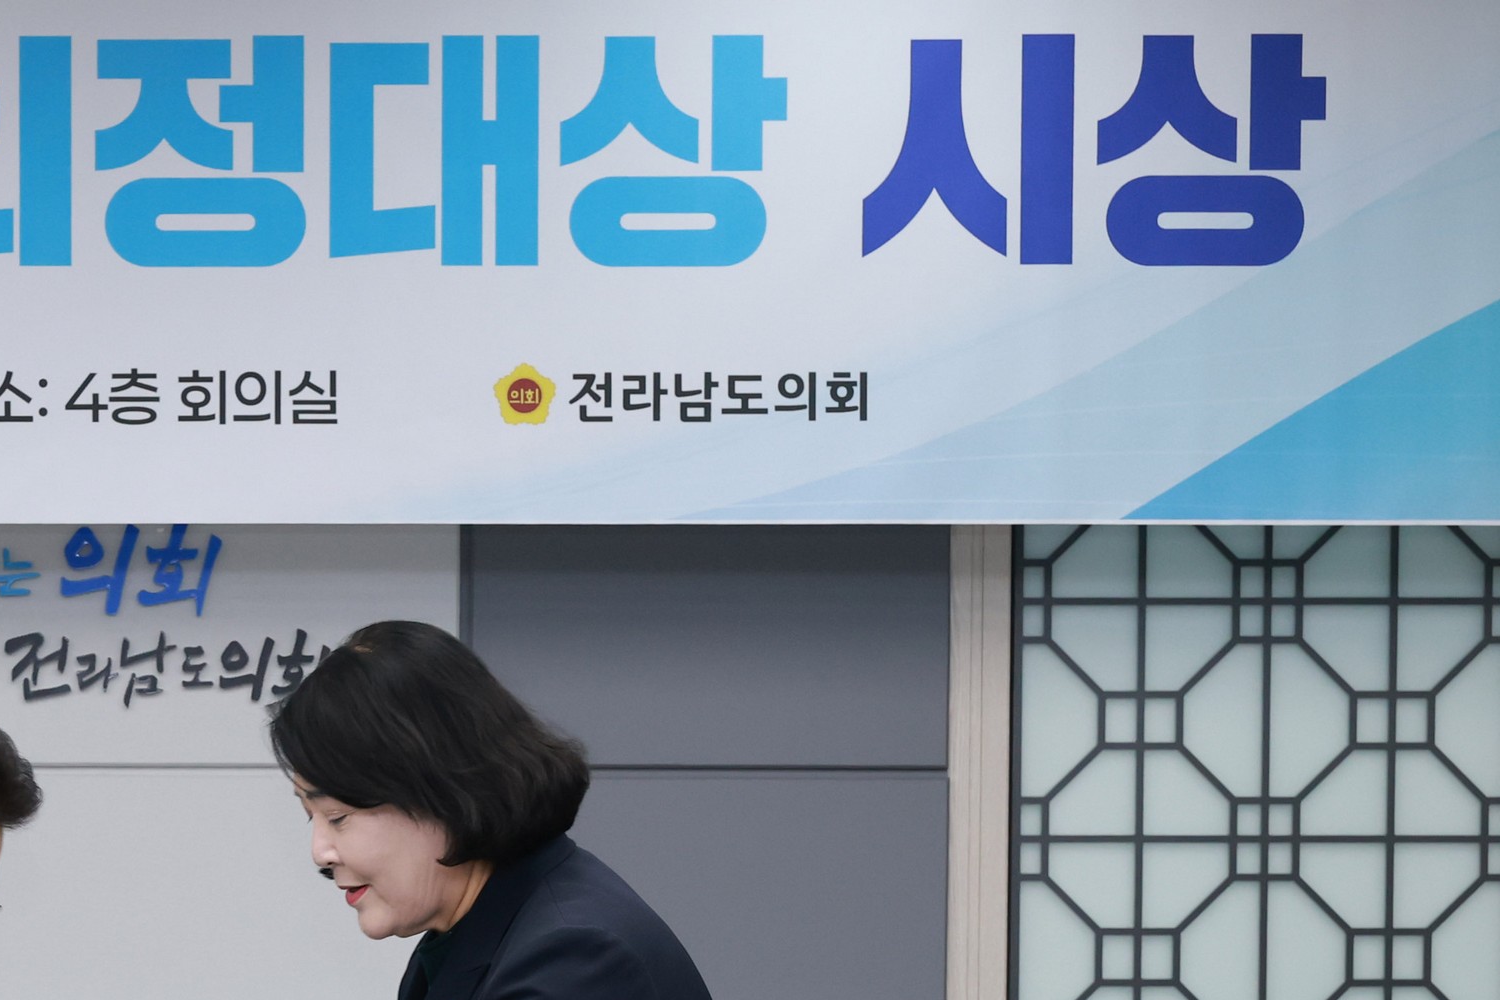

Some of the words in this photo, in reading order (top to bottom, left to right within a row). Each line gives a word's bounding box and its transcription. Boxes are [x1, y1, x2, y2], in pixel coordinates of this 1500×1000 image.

[862, 33, 1328, 267] 시상
[64, 367, 160, 425] 4층
[177, 369, 338, 425] 회의실
[509, 387, 539, 404] 의회
[568, 371, 868, 423] 전라남도의회
[60, 524, 222, 616] 의회
